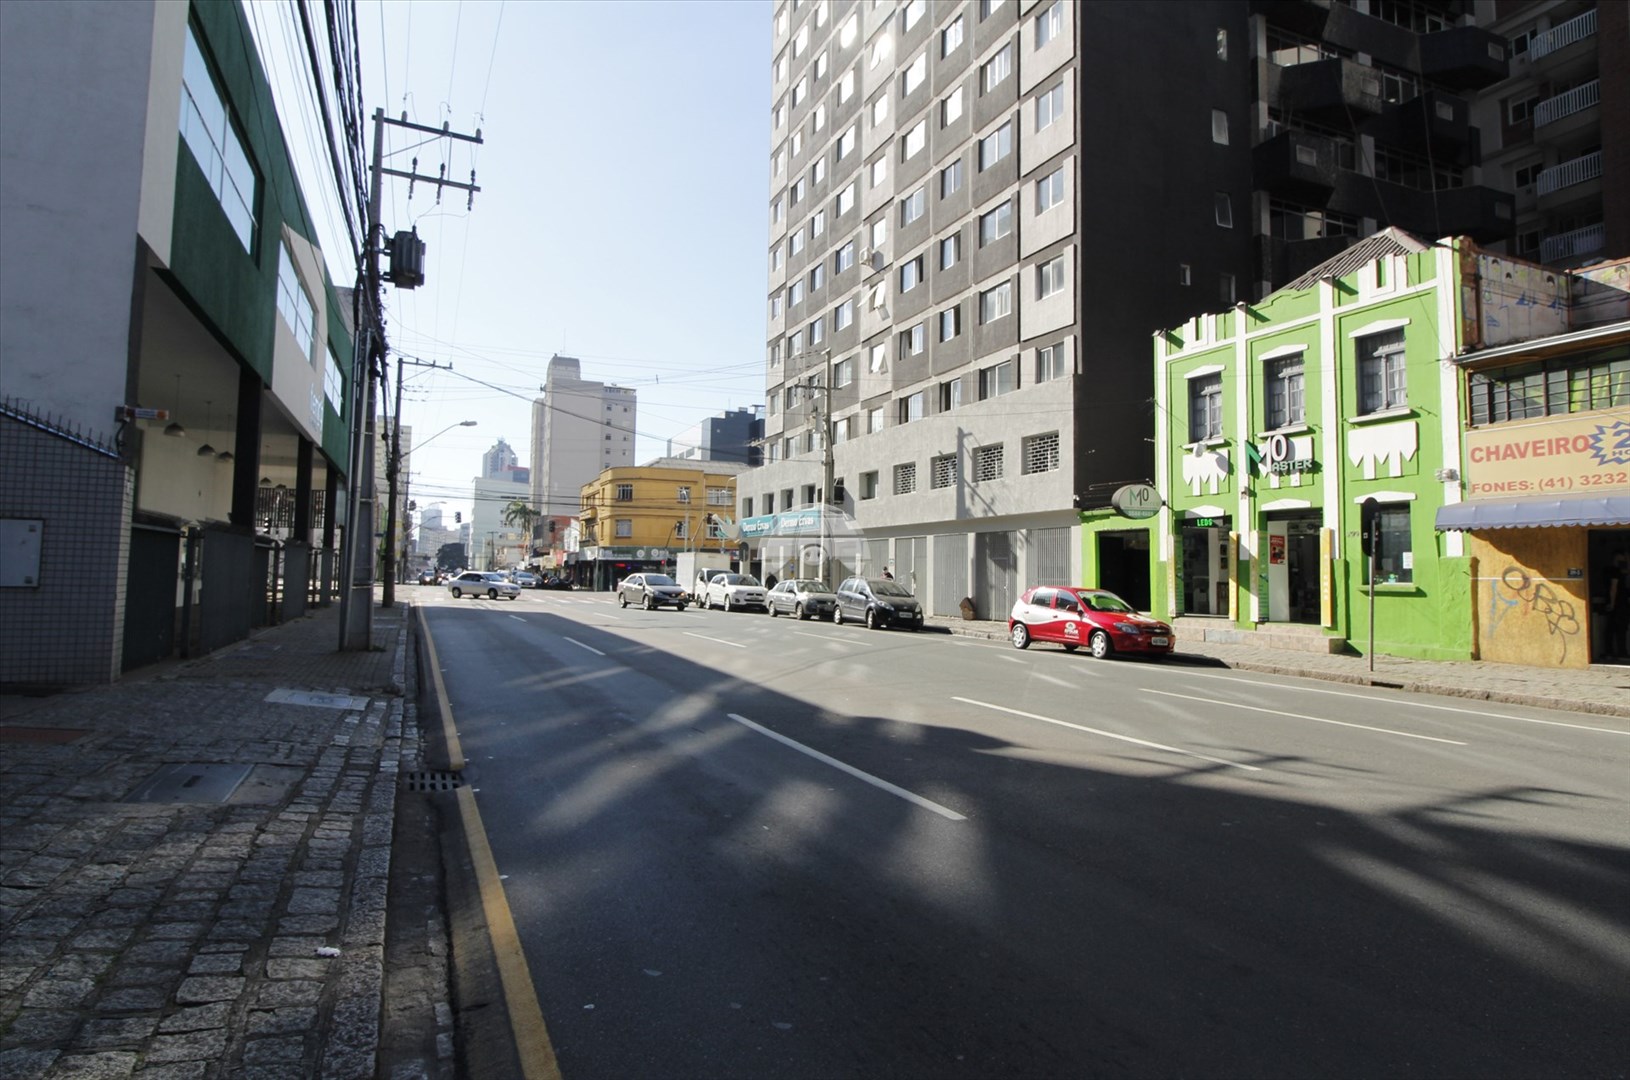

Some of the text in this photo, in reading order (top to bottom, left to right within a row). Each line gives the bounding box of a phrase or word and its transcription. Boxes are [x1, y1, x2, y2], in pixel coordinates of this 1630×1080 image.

[1470, 434, 1590, 464] CHAVEIRO
[1471, 472, 1628, 494] FONES: (41) 3232
